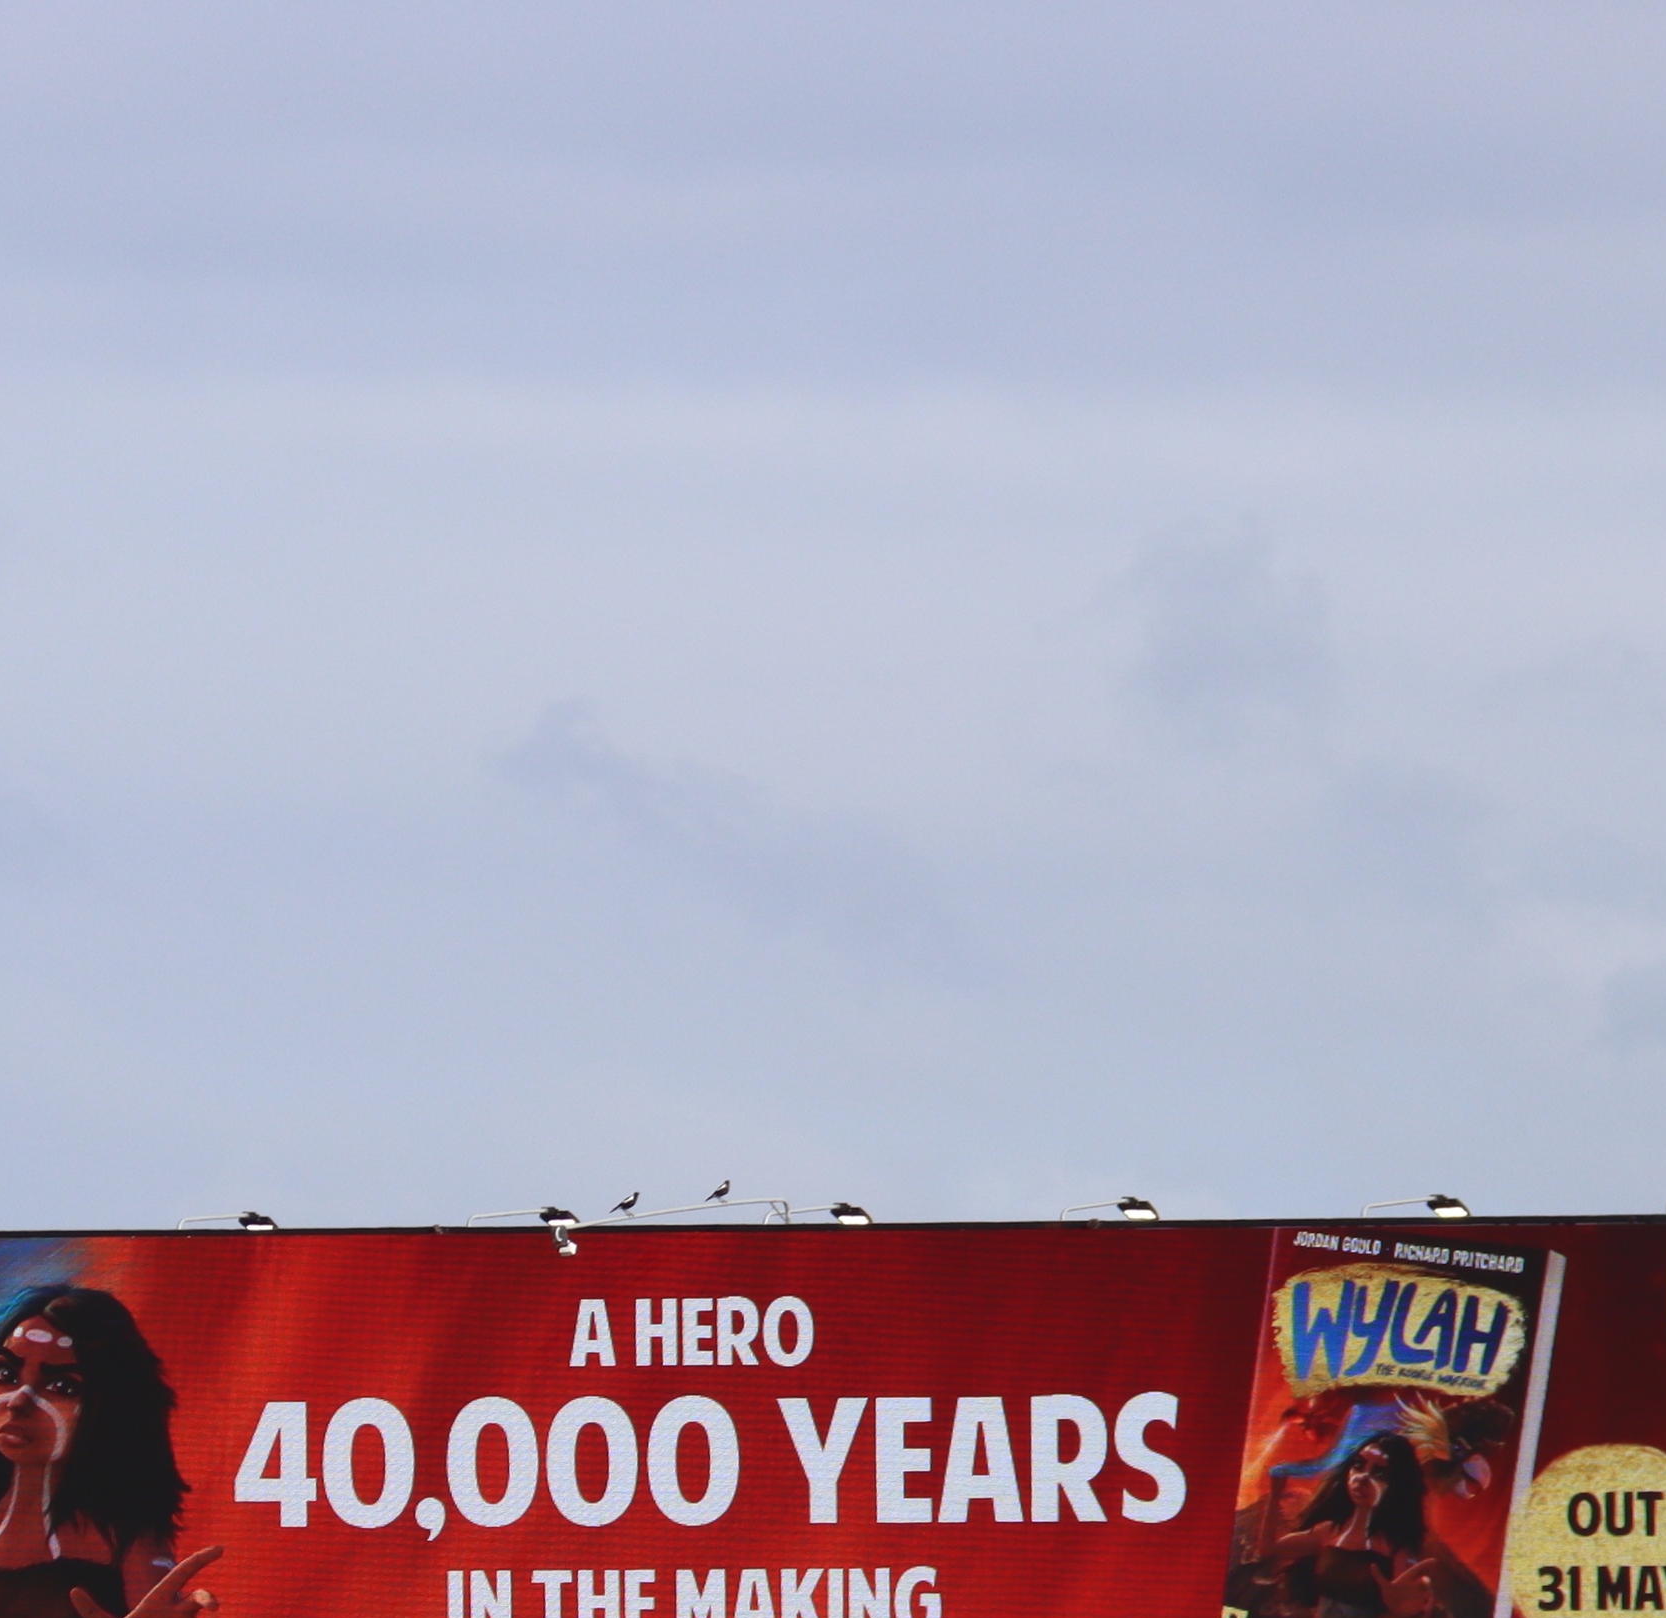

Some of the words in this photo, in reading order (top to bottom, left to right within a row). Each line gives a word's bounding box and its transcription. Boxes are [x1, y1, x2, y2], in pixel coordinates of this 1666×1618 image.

[1293, 1231, 1339, 1251] JORDAN
[1342, 1236, 1382, 1256] GOULD
[1393, 1242, 1450, 1265] RICHARD
[1452, 1249, 1525, 1275] PRITCHARD
[569, 1298, 616, 1367] A
[635, 1295, 814, 1367] HERO
[1292, 1279, 1510, 1381] WYLAH
[234, 1394, 740, 1542] 40,000
[777, 1391, 1187, 1524] YEARS
[1567, 1491, 1664, 1537] OUT
[1538, 1565, 1581, 1612] 31
